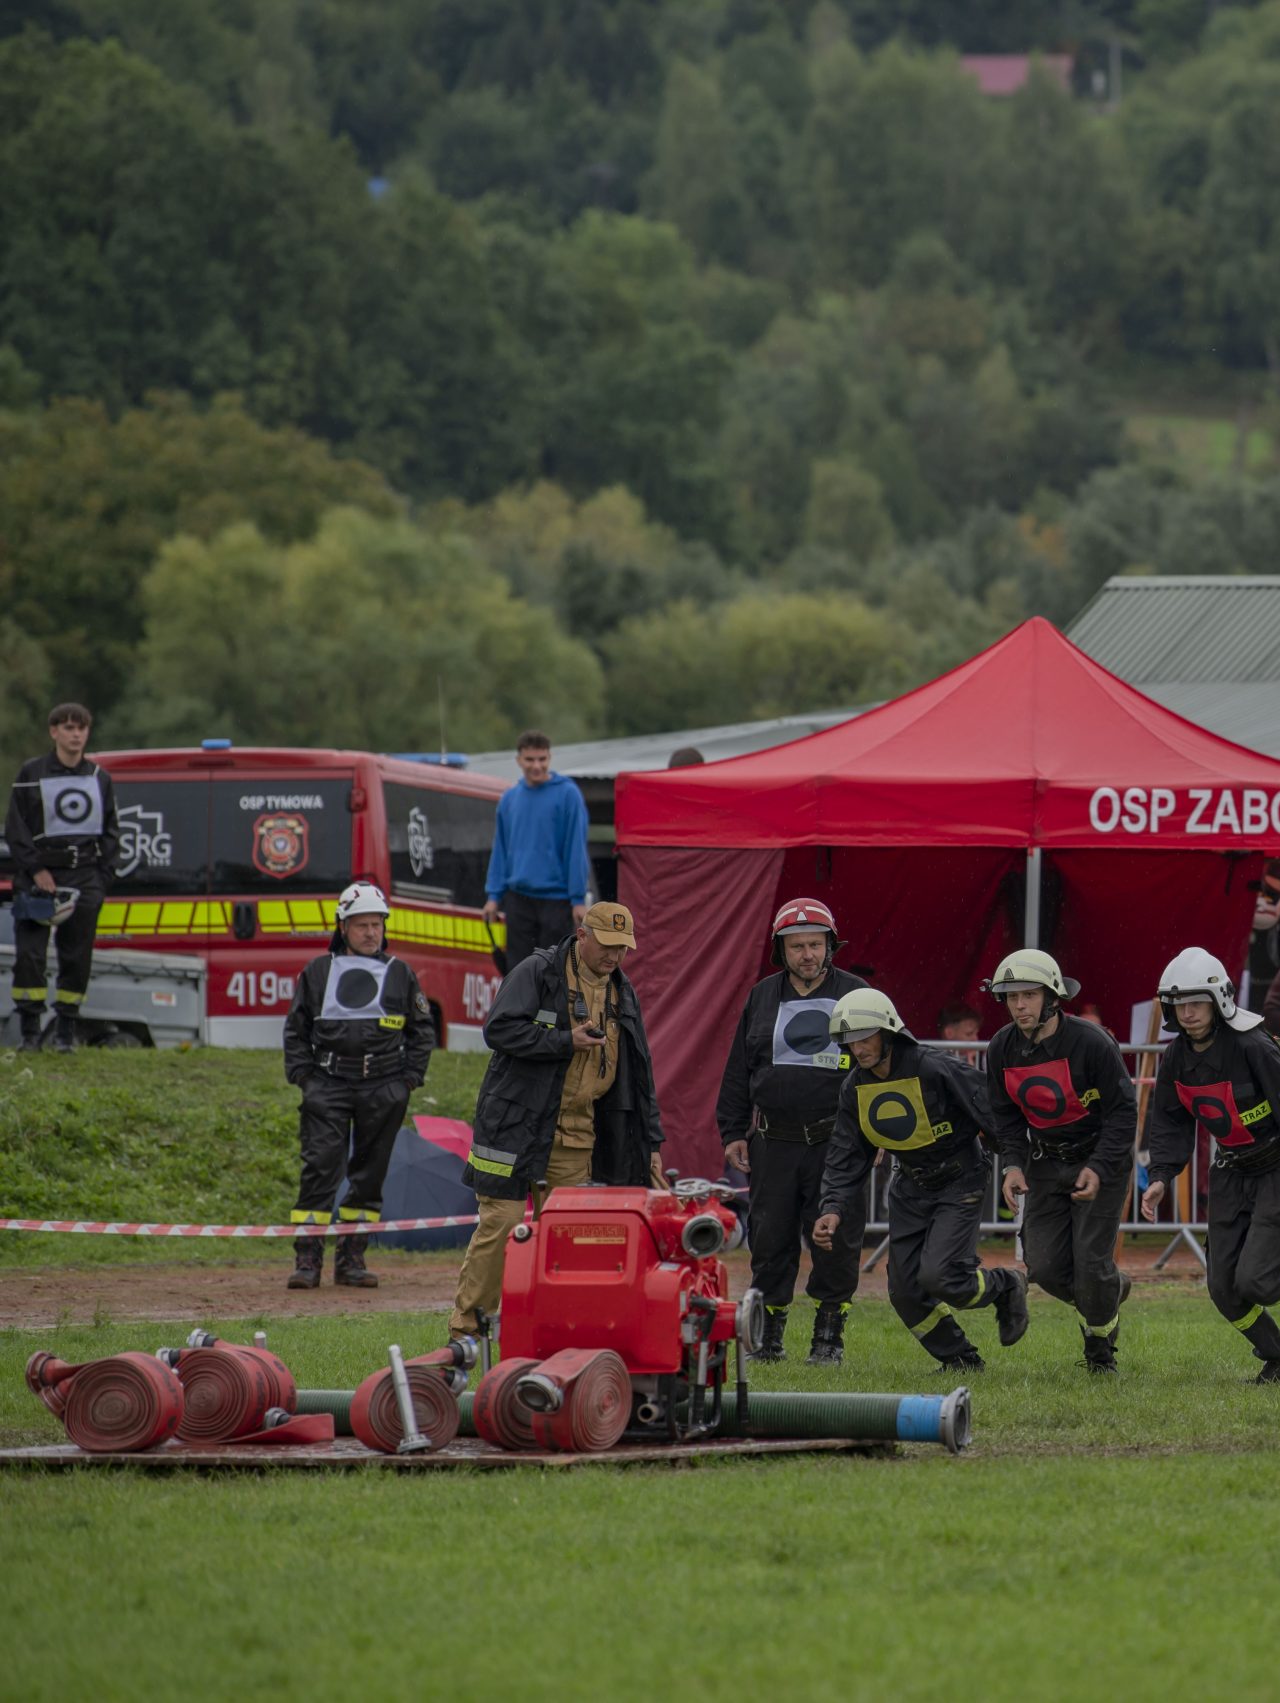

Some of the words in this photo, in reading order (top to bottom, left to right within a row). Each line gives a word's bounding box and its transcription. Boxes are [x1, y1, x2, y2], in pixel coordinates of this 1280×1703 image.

[239, 796, 265, 810] OSP
[266, 795, 324, 810] TYMOWA
[1089, 787, 1176, 833] OSP
[118, 832, 172, 860] SRG
